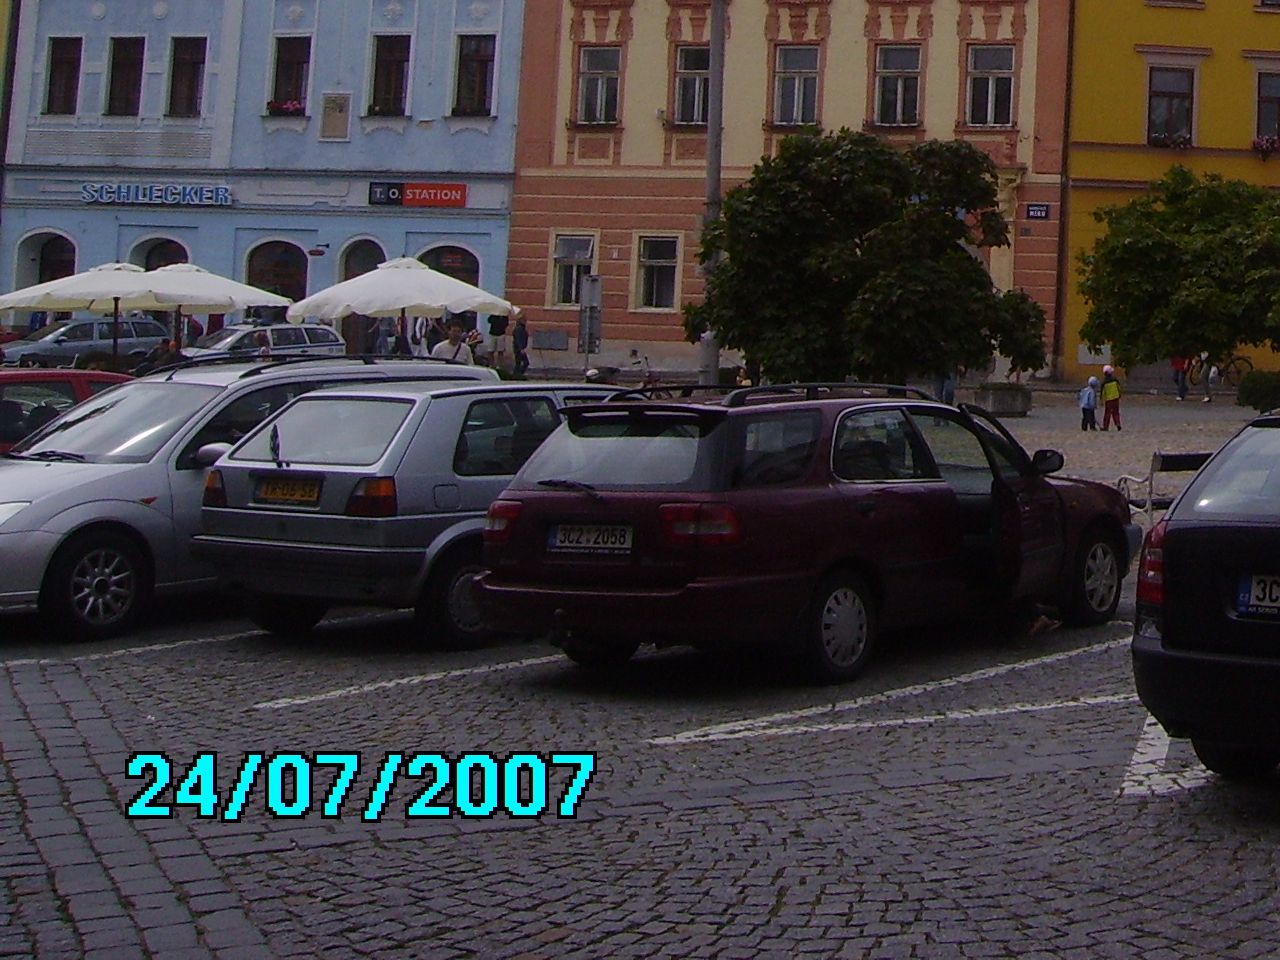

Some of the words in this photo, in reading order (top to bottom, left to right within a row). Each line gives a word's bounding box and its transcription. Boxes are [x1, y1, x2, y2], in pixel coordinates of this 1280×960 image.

[81, 182, 233, 206] SCHLECKER
[405, 189, 461, 200] STATION
[594, 528, 627, 545] 2058
